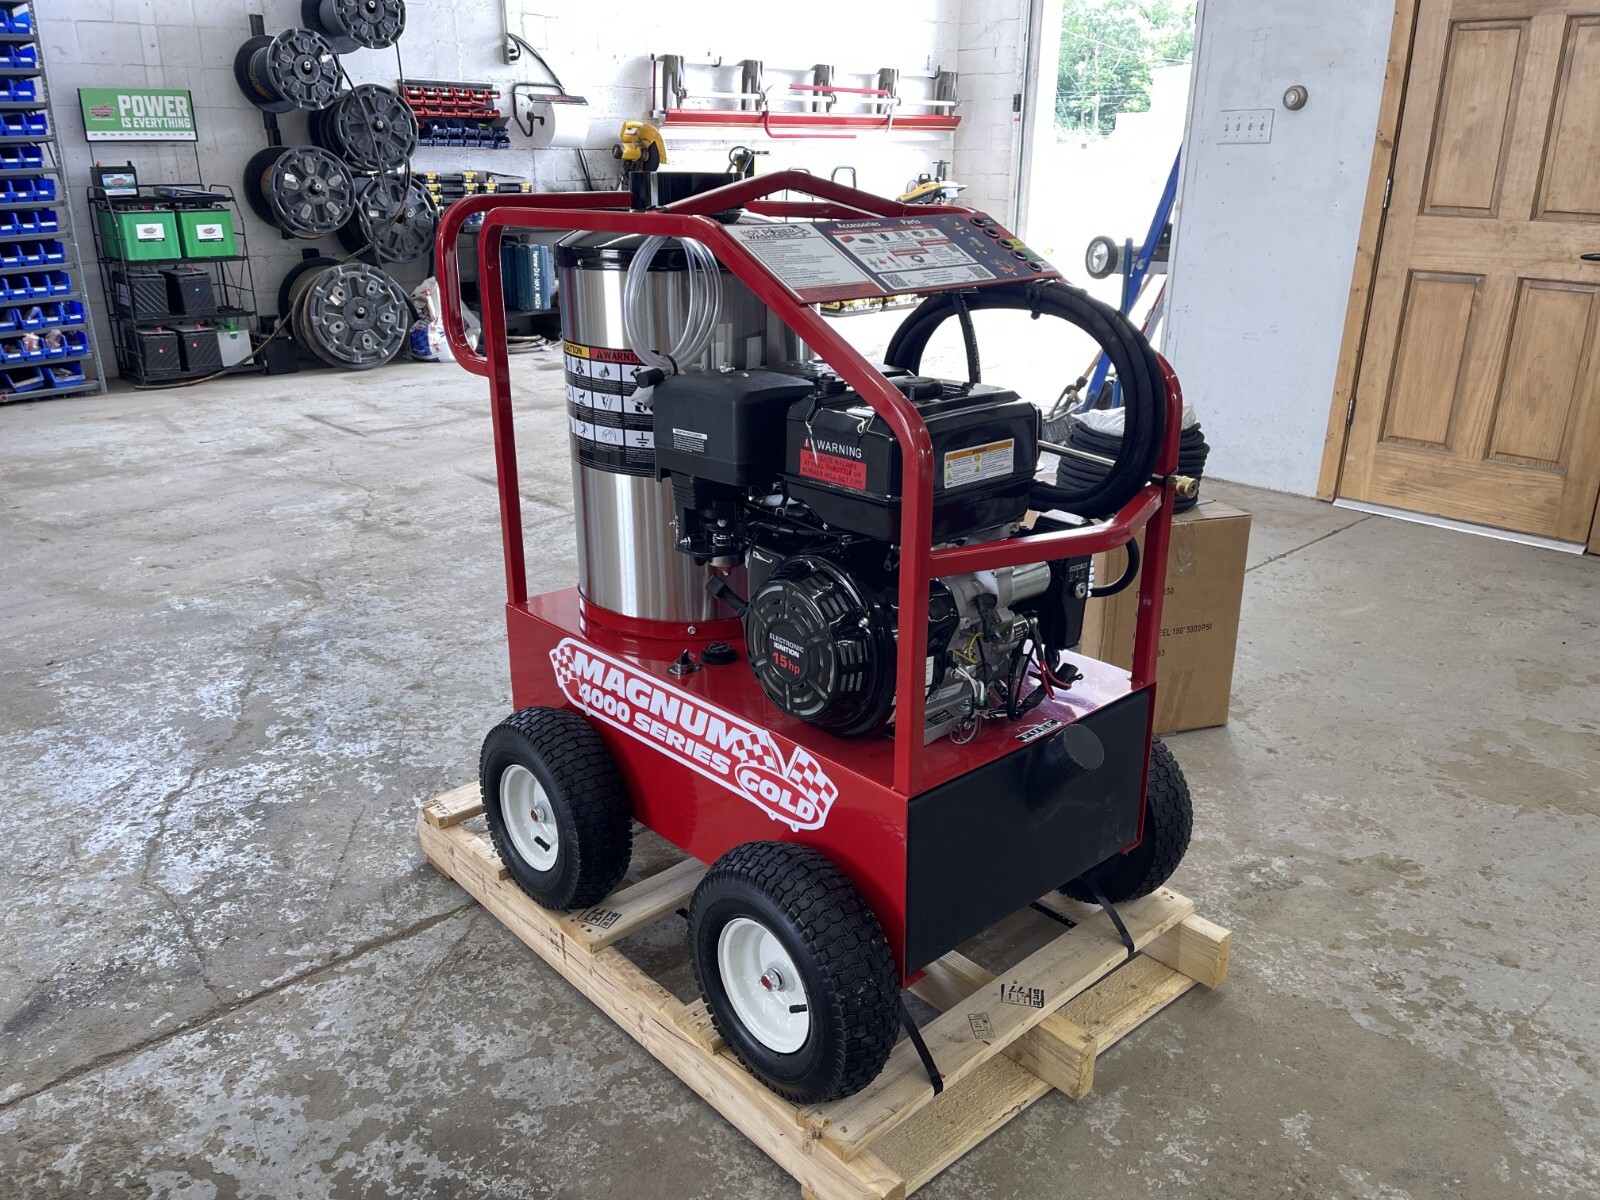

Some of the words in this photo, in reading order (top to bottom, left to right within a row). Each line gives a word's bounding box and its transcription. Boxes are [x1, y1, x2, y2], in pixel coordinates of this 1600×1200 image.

[117, 95, 189, 117] POWER
[121, 117, 131, 128] IS
[133, 117, 191, 128] EVERYTHING
[837, 220, 881, 229] Accessories
[900, 218, 921, 226] Parts
[816, 439, 863, 459] WARNING
[826, 464, 852, 476] THROTTLE
[834, 458, 858, 470] MACHINE
[824, 472, 837, 480] WILL
[769, 632, 805, 653] ELECTRONIC
[773, 641, 800, 658] IGNITION
[573, 649, 747, 756] MAGNUM
[578, 684, 631, 724] 4000
[633, 712, 732, 775] SERIES
[739, 768, 816, 822] GOLD
